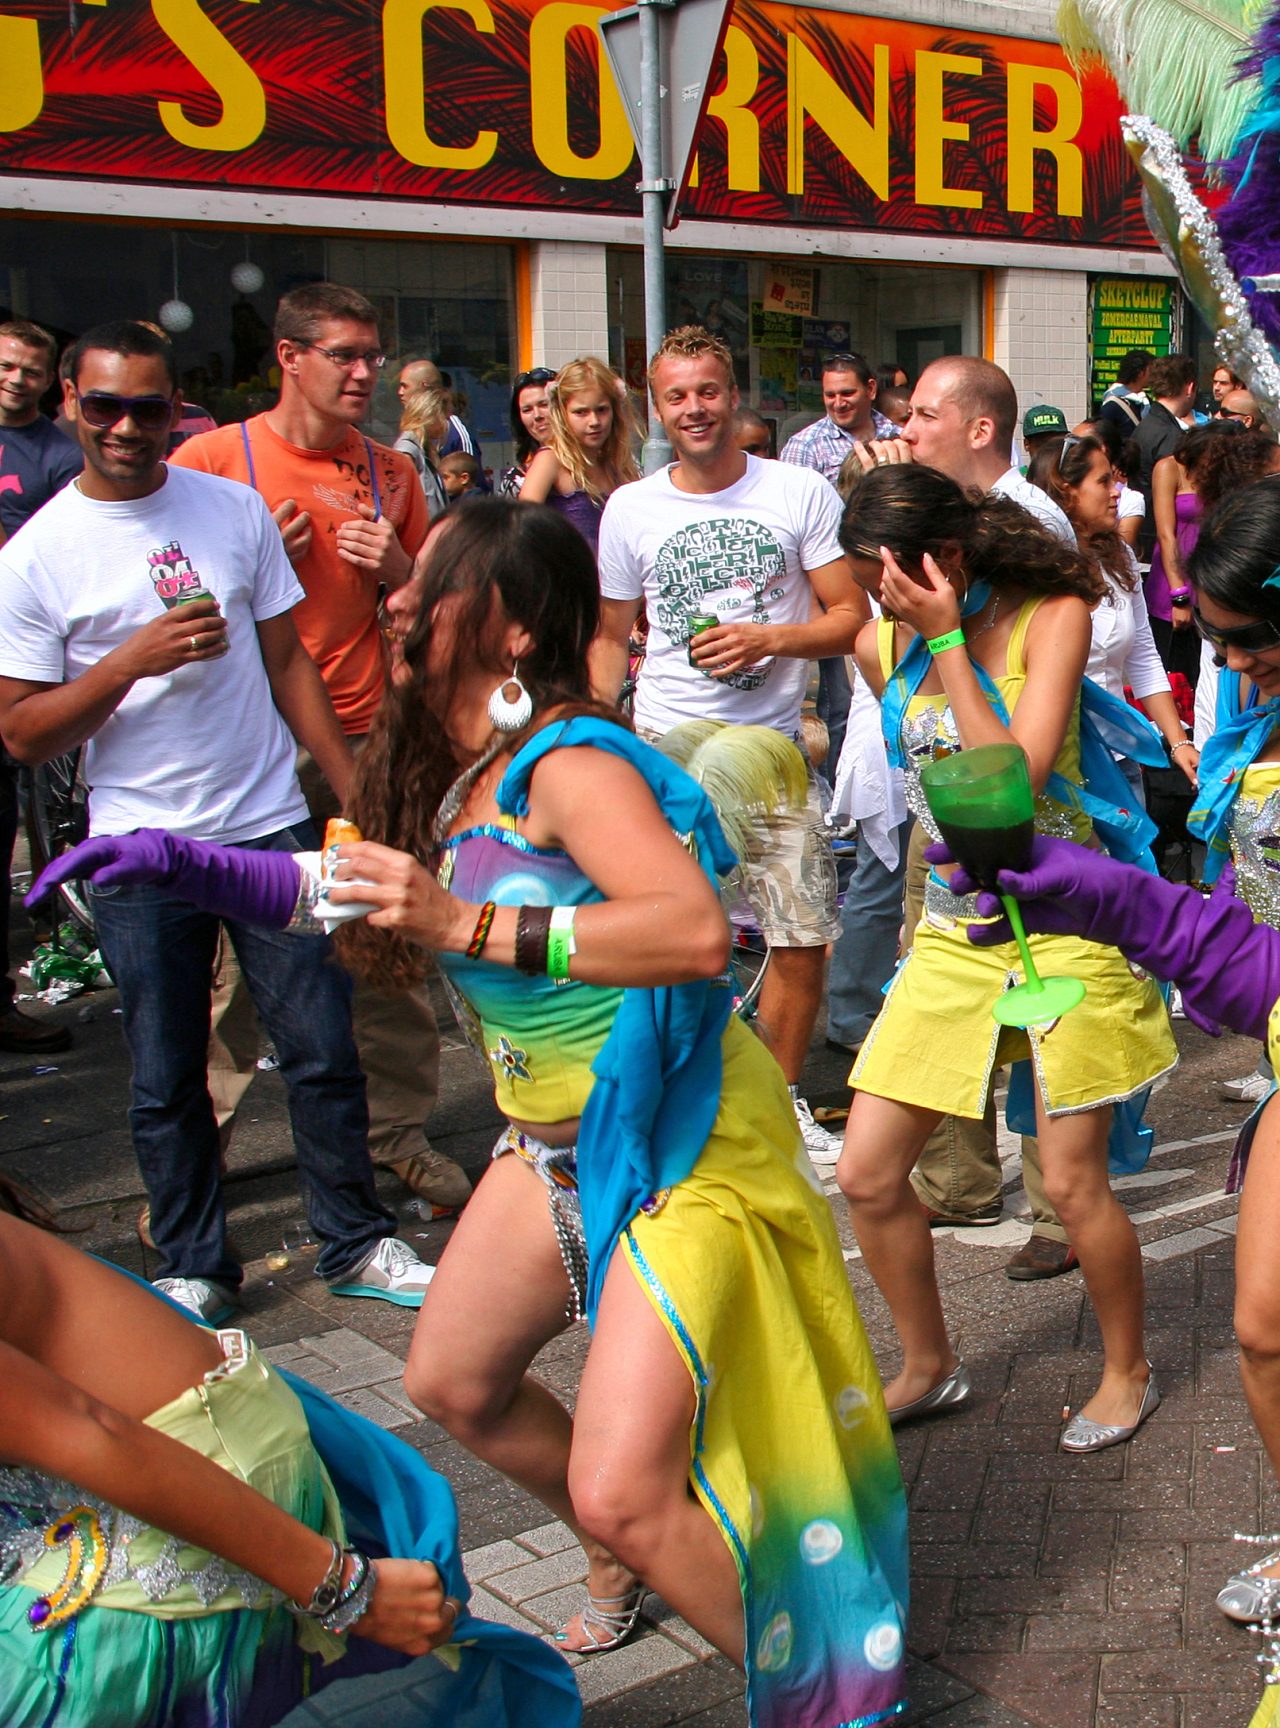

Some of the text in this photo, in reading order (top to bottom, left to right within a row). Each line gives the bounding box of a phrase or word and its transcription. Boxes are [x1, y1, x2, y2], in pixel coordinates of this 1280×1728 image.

[382, 0, 1084, 217] CORNER
[685, 272, 722, 282] LOVE
[1102, 312, 1162, 328] ZOMERCARNAVAL
[1109, 330, 1154, 344] AFTERPARTY
[1033, 415, 1060, 427] HULK
